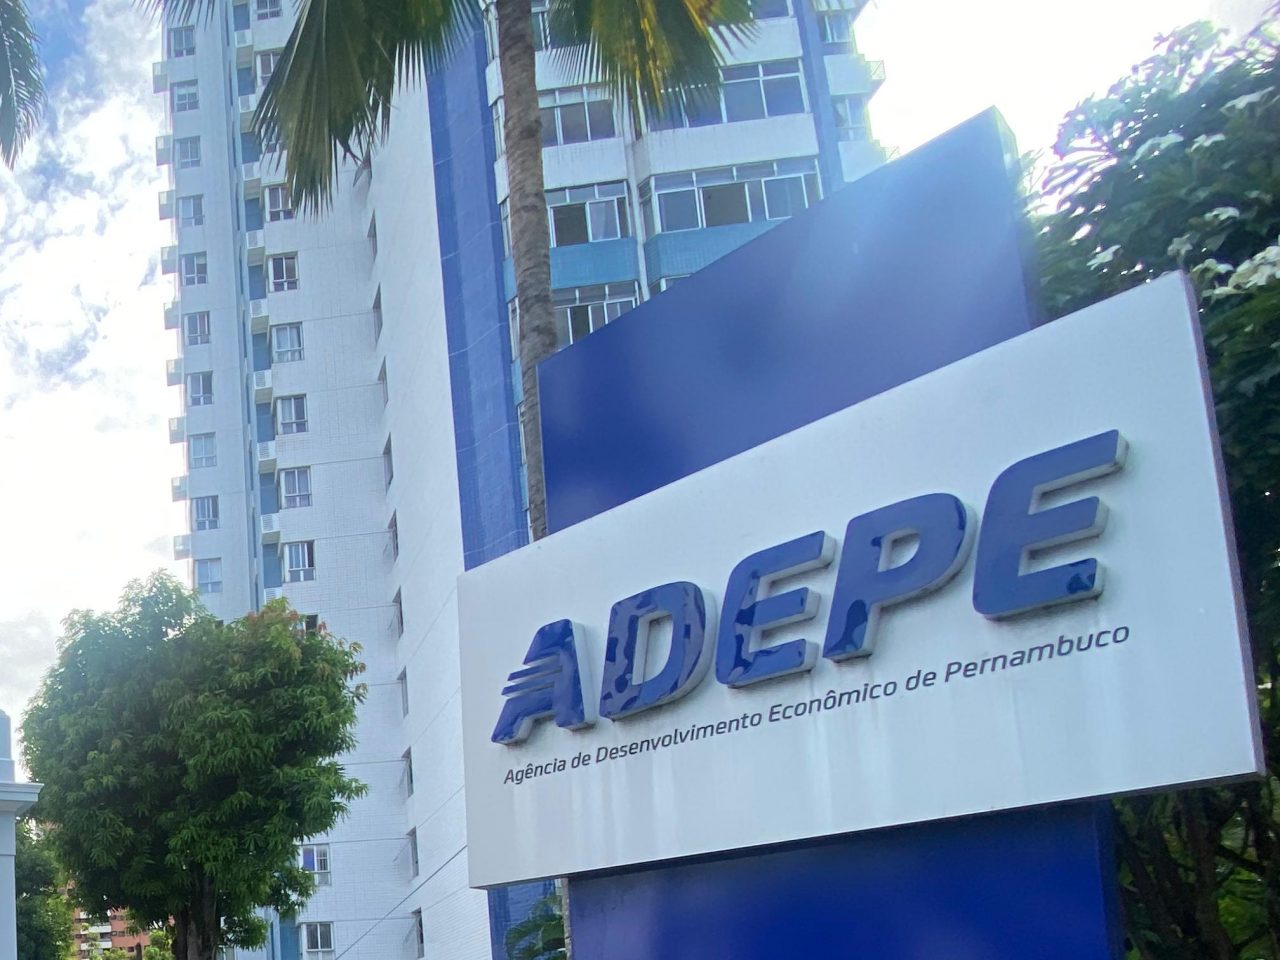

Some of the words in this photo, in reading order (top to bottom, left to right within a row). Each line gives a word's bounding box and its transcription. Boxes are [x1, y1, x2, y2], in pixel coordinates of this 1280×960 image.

[491, 429, 1128, 746] ADEPE
[503, 758, 566, 785] Agência
[571, 751, 591, 769] de
[595, 711, 762, 763] Desenvolvimento
[768, 680, 898, 723] Econômico
[905, 669, 937, 691] de
[944, 625, 1130, 684] Pernambuco
